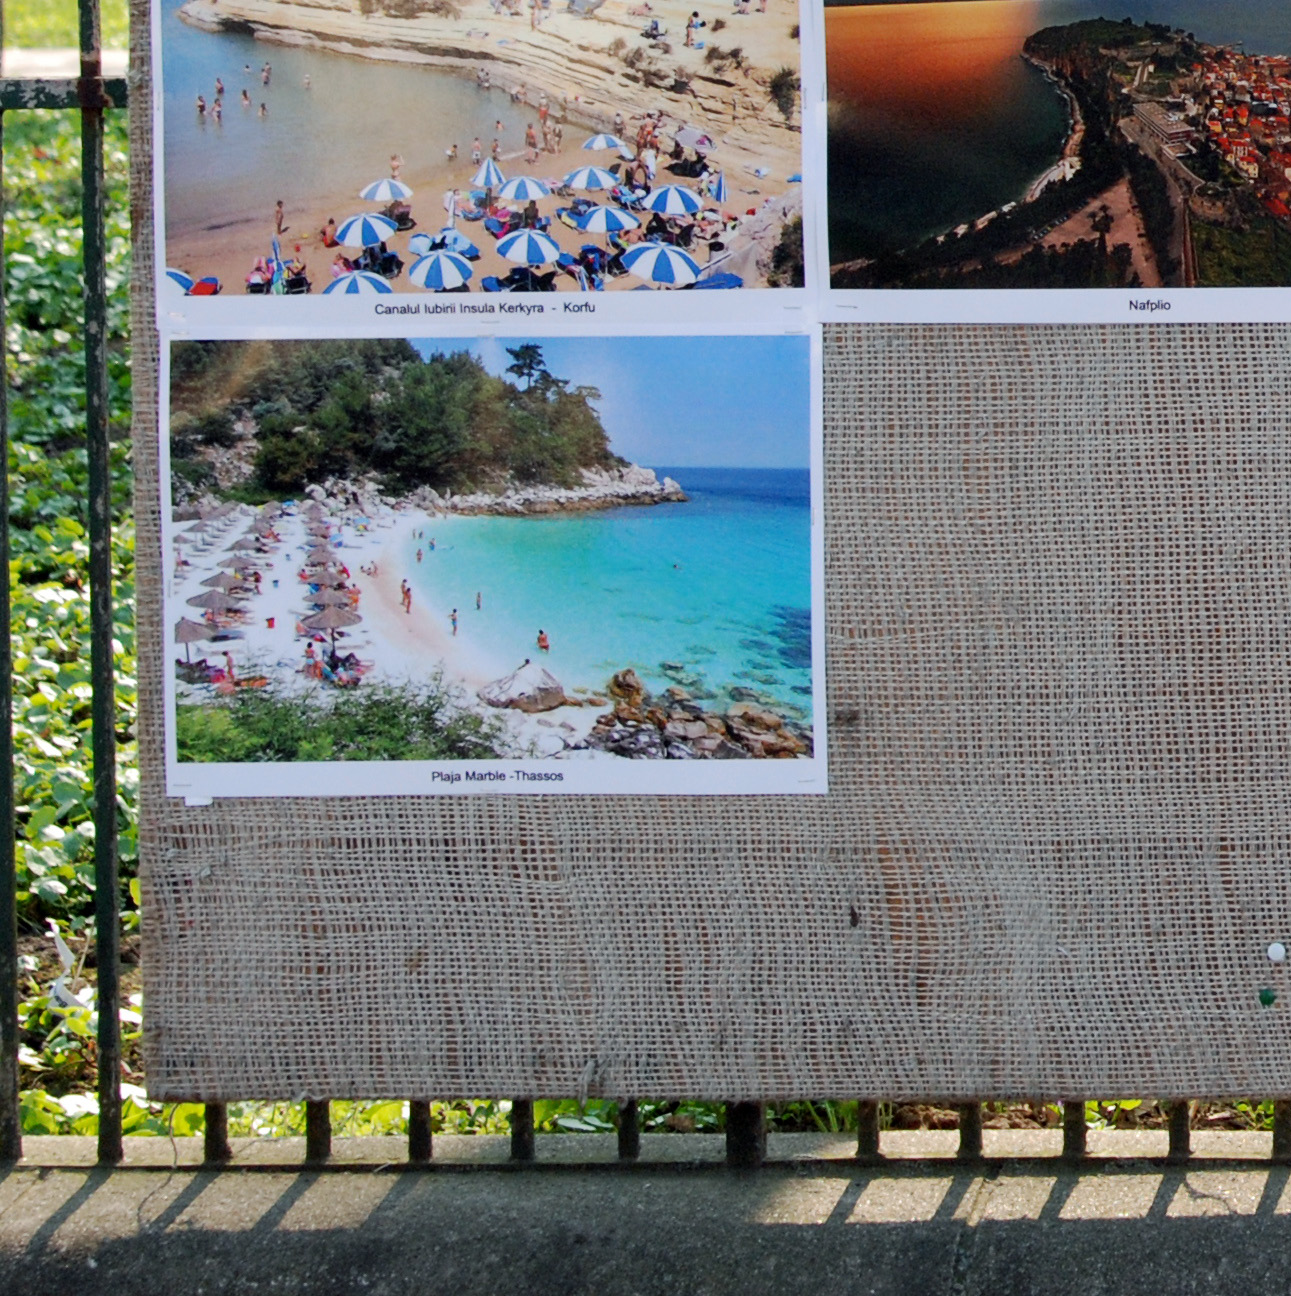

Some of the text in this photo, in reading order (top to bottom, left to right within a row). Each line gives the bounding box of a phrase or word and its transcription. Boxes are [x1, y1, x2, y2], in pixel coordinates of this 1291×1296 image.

[374, 303, 420, 315] Canalul
[460, 302, 495, 314] Insula
[499, 302, 544, 316] Kerkyra
[563, 301, 596, 313] Korfu
[1129, 299, 1171, 312] Nafplio
[431, 771, 461, 783] Plaja
[465, 770, 506, 781] Marble
